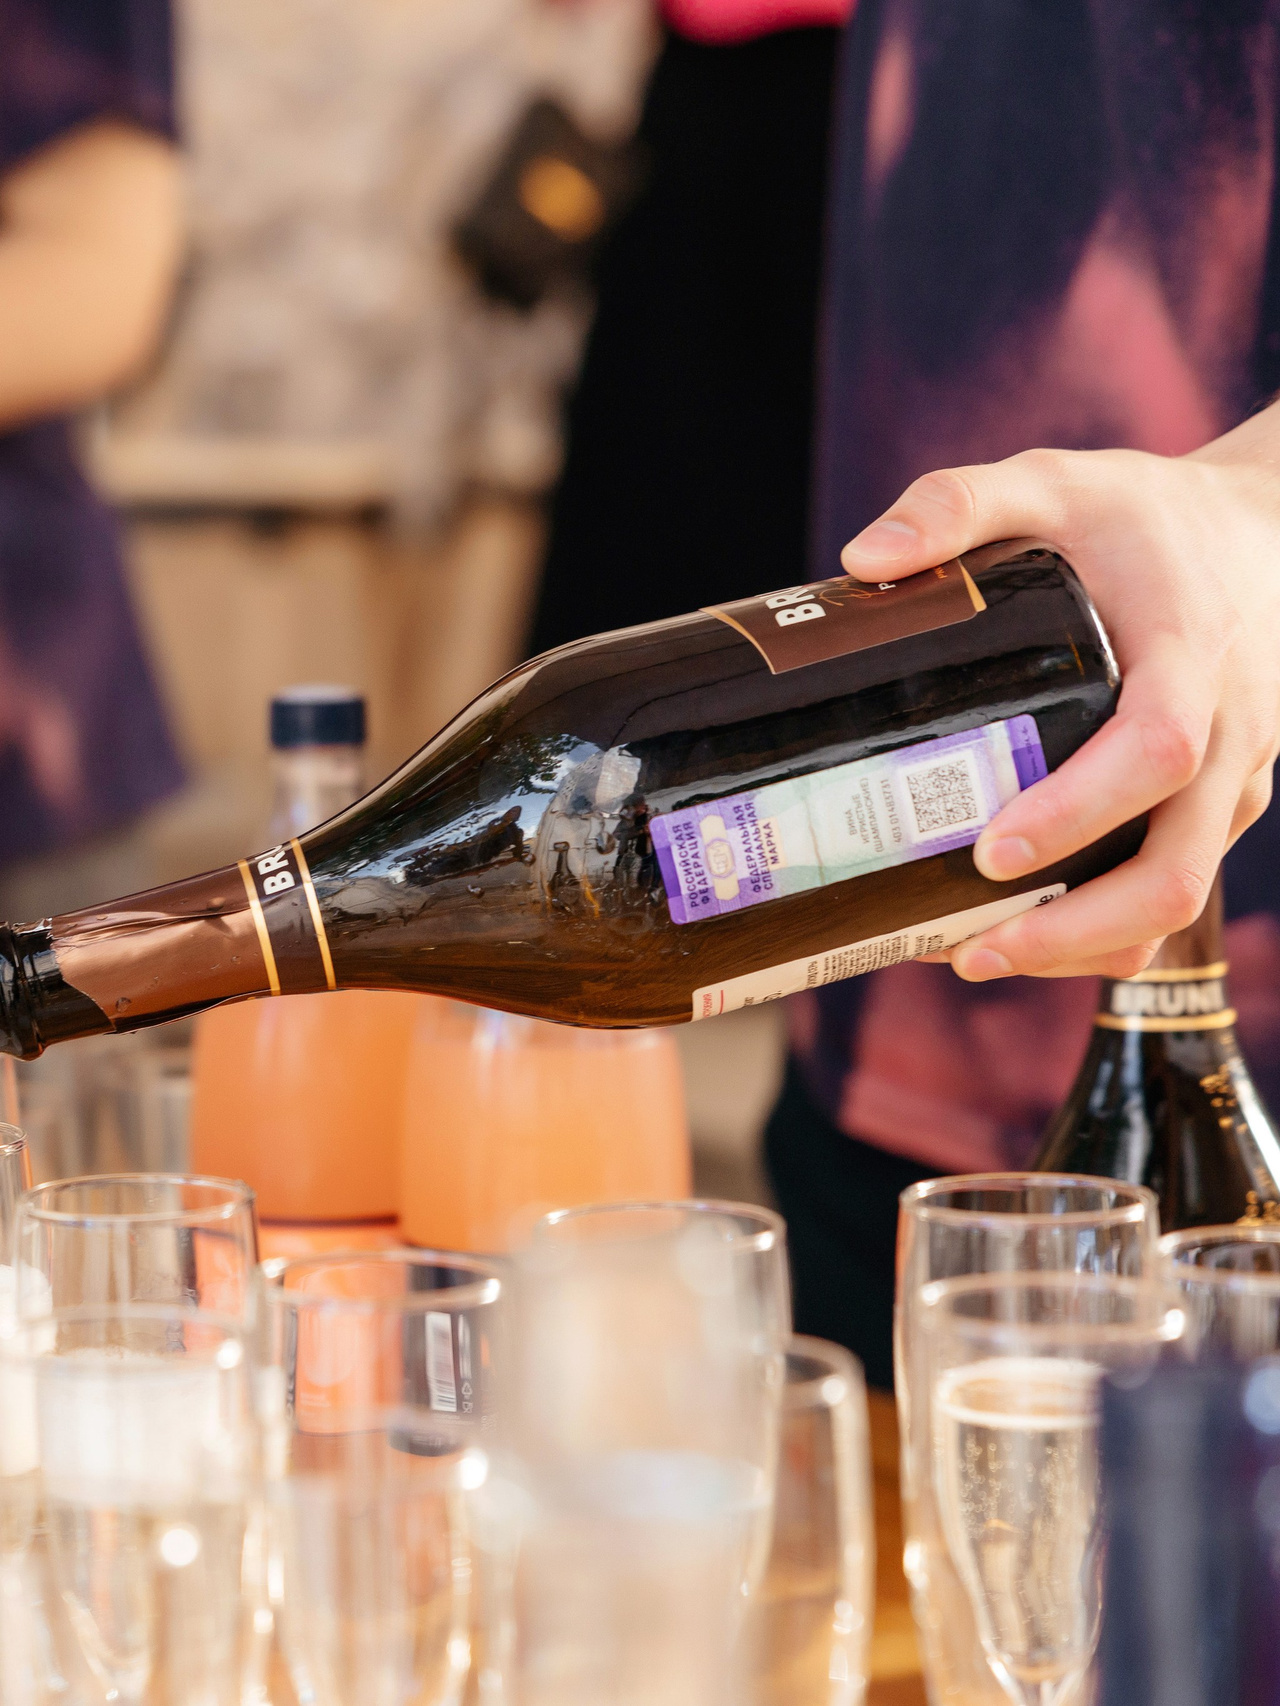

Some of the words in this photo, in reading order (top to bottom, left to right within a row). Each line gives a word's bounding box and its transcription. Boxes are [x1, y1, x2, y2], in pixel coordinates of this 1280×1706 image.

[733, 804, 762, 893] ФЕДЕРАЛЬНАЯ
[744, 802, 773, 890] СПЕЦИАЛЬНАЯ
[763, 822, 780, 865] МАРКА
[845, 810, 856, 836] ВИНА
[852, 793, 870, 844] ИГРИСТЫЕ
[672, 824, 700, 908] РОССИЙСКАЯ
[683, 821, 710, 905] ФЕДЕРАЦИЯ
